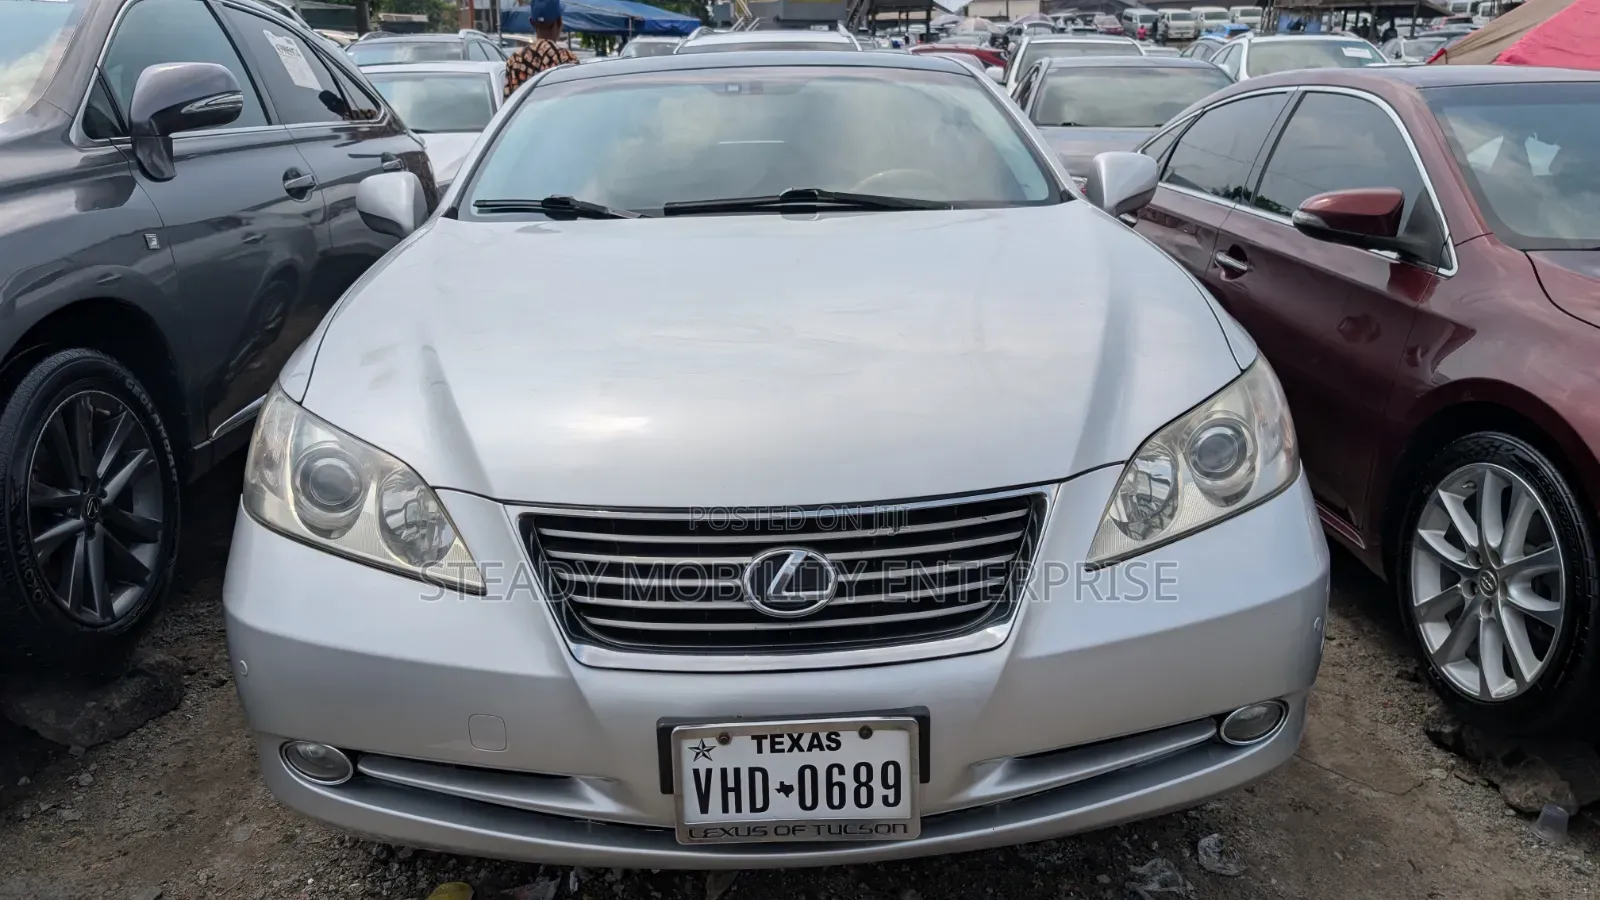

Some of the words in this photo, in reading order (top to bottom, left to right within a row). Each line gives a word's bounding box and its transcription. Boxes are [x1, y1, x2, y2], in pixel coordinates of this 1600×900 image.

[751, 732, 842, 754] TEXAS
[692, 766, 770, 815] VHD
[797, 760, 902, 812] 0689
[689, 825, 768, 839] LEXUS
[774, 825, 806, 837] OF
[813, 823, 908, 836] TUCSON
